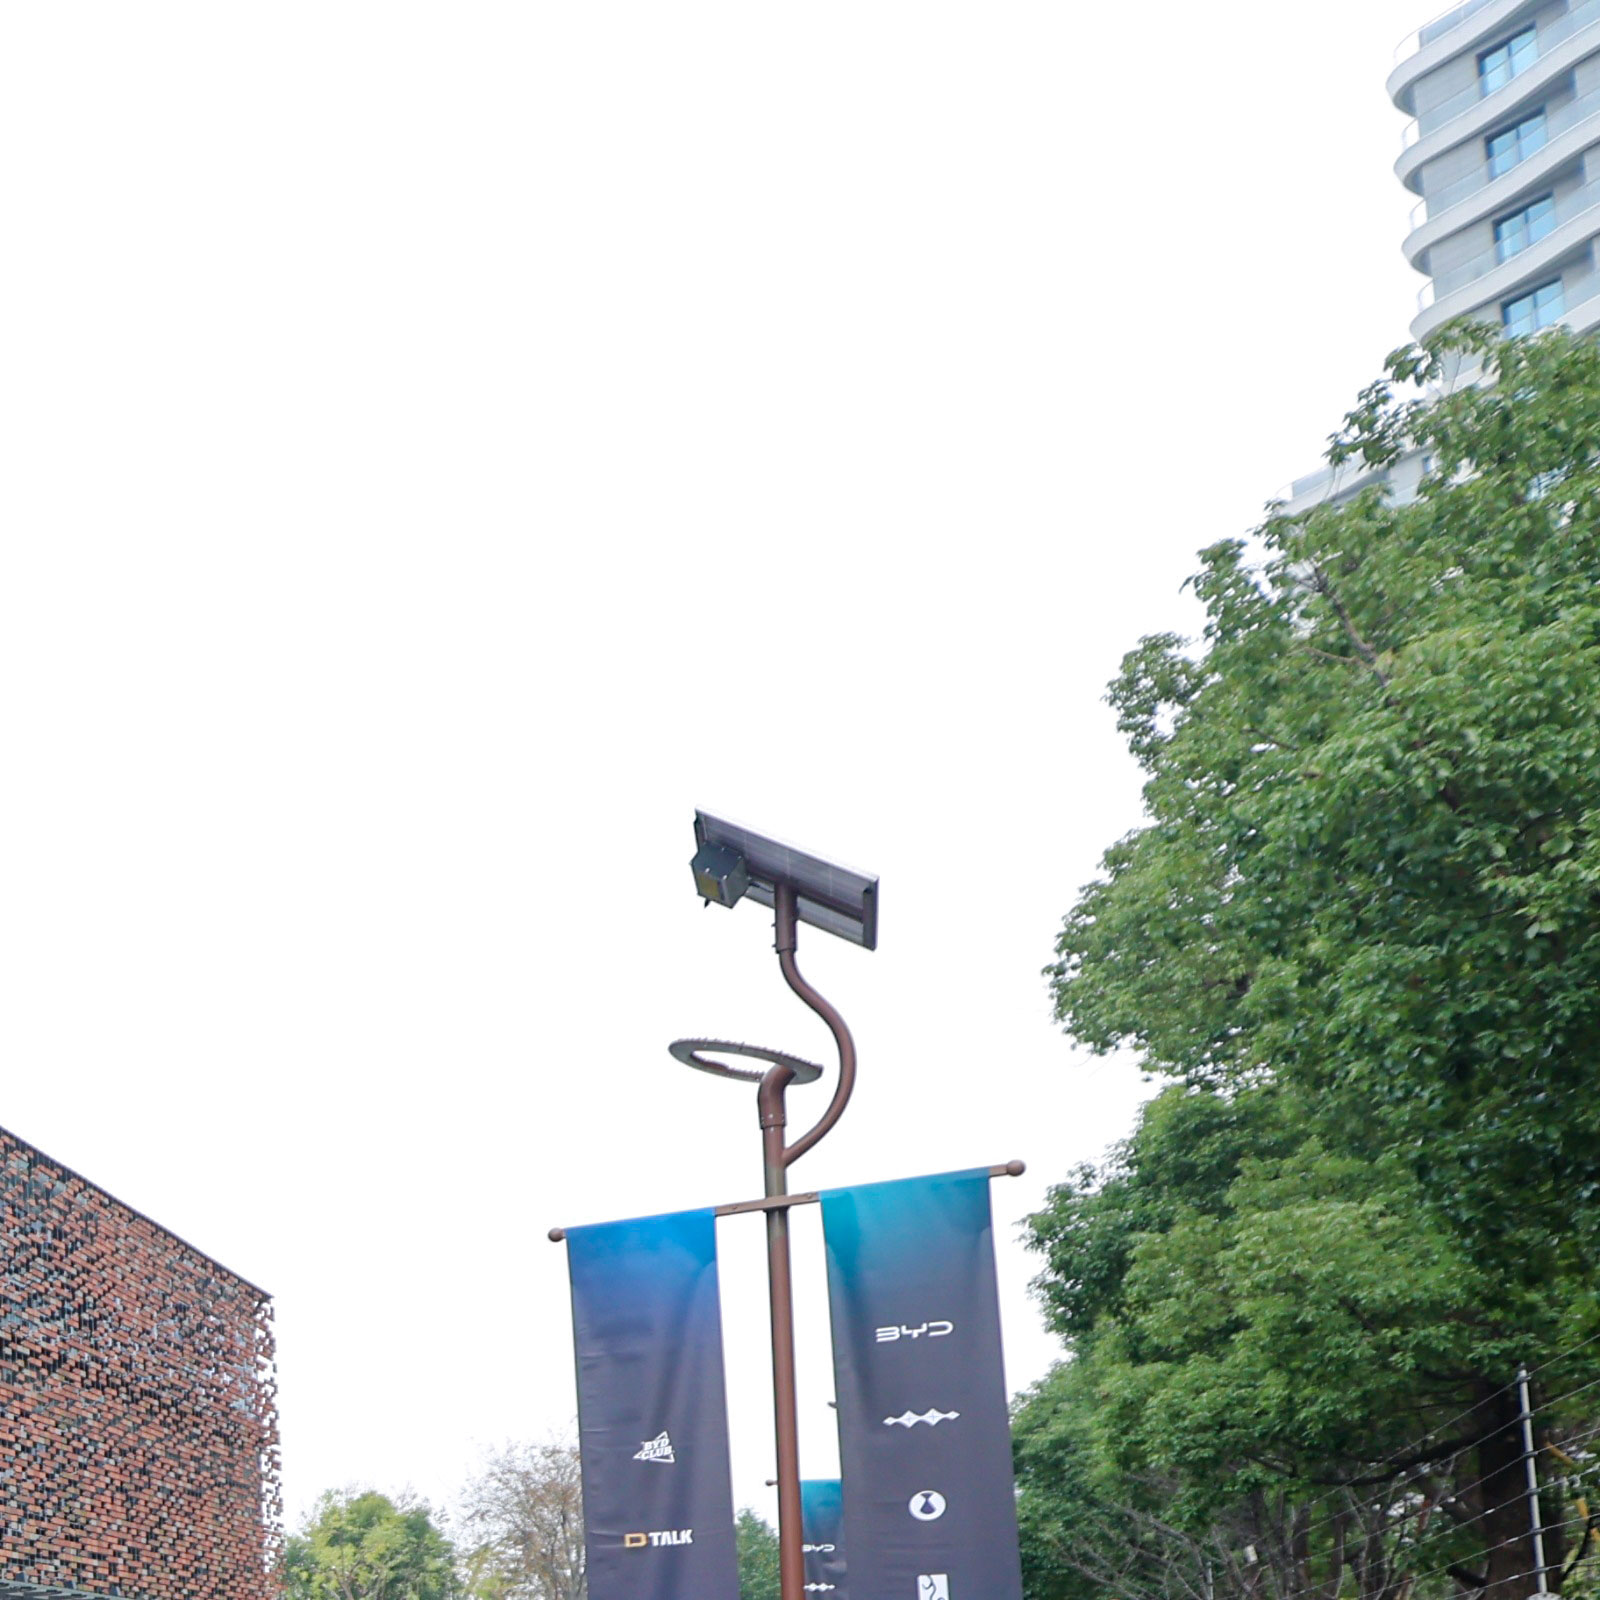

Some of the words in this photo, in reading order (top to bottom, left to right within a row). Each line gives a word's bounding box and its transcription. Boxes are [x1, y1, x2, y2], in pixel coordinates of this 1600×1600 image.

[875, 1320, 954, 1343] BYD
[640, 1445, 673, 1461] CLUB
[643, 1437, 671, 1452] BYD
[648, 1529, 694, 1547] TALK
